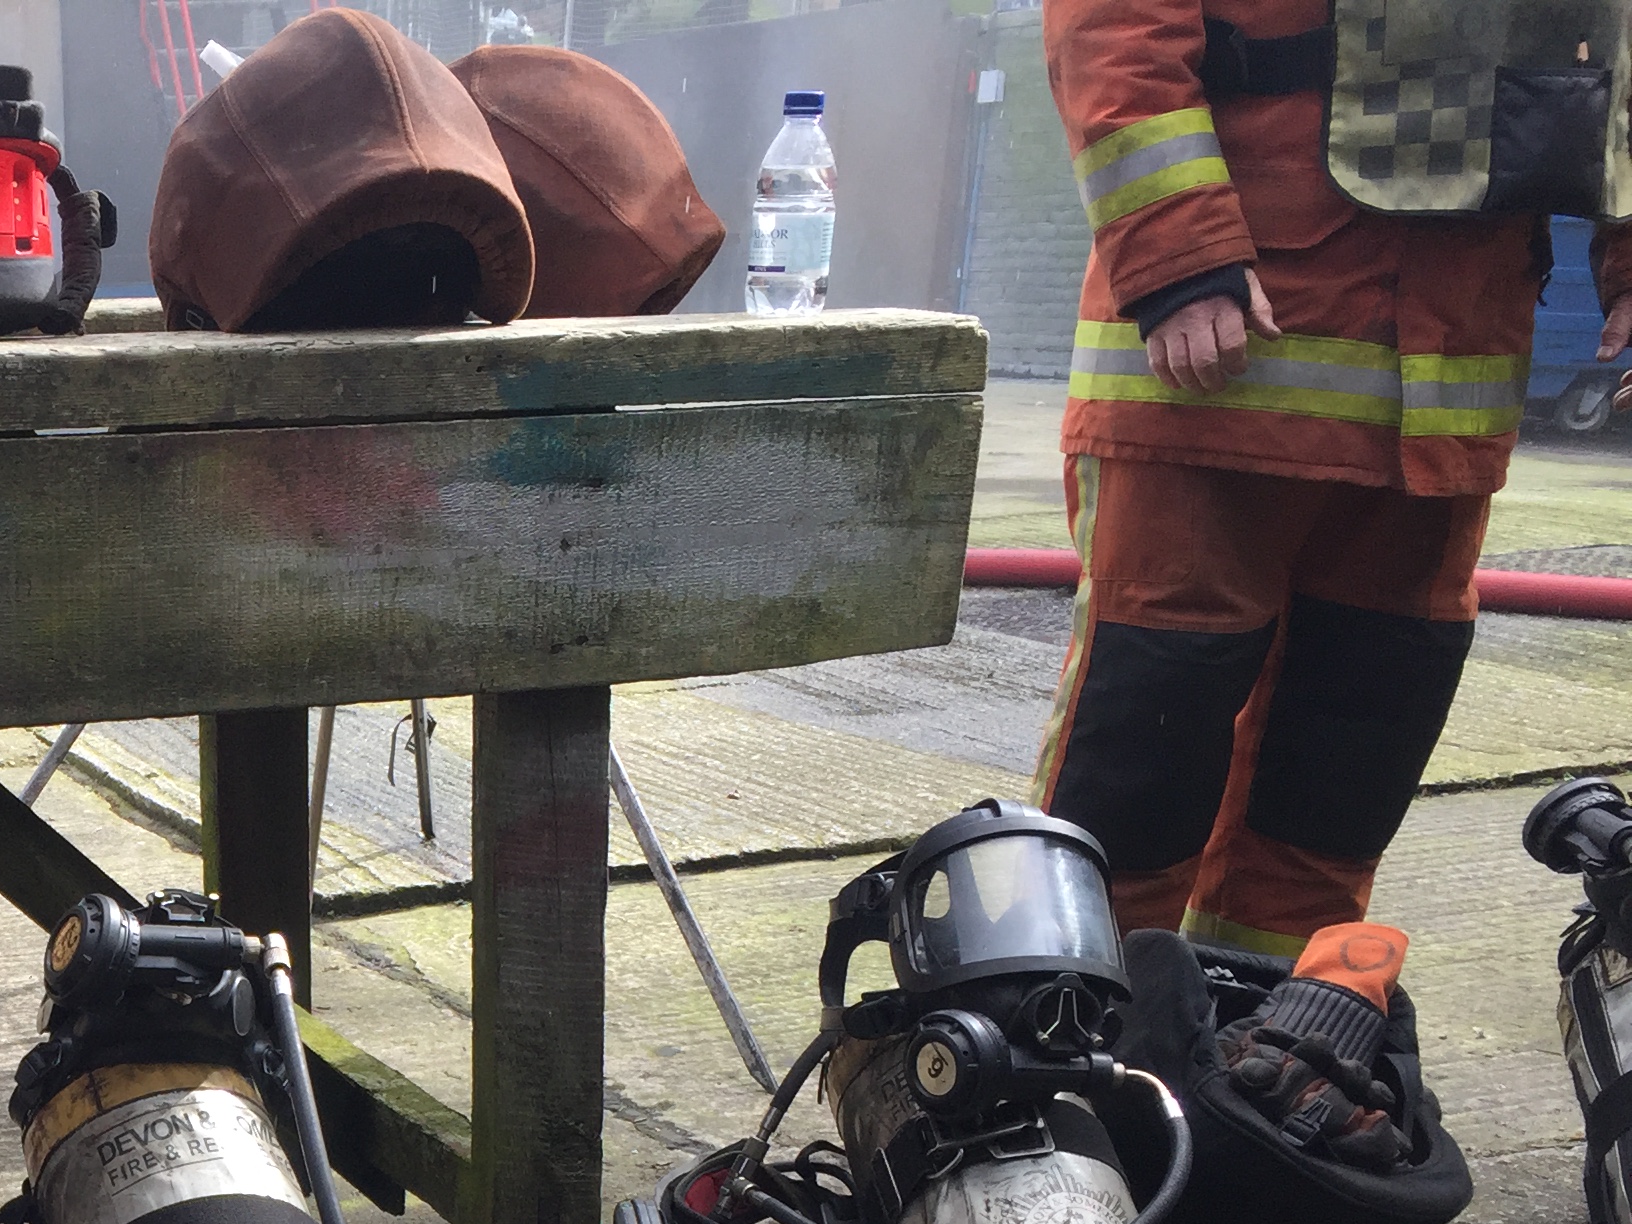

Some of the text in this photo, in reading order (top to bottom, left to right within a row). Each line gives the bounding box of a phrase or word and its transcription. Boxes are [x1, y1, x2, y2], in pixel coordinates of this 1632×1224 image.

[96, 1112, 195, 1167] DEVON
[199, 1110, 217, 1131] &
[107, 1156, 159, 1187] FIRE
[165, 1143, 182, 1162] &
